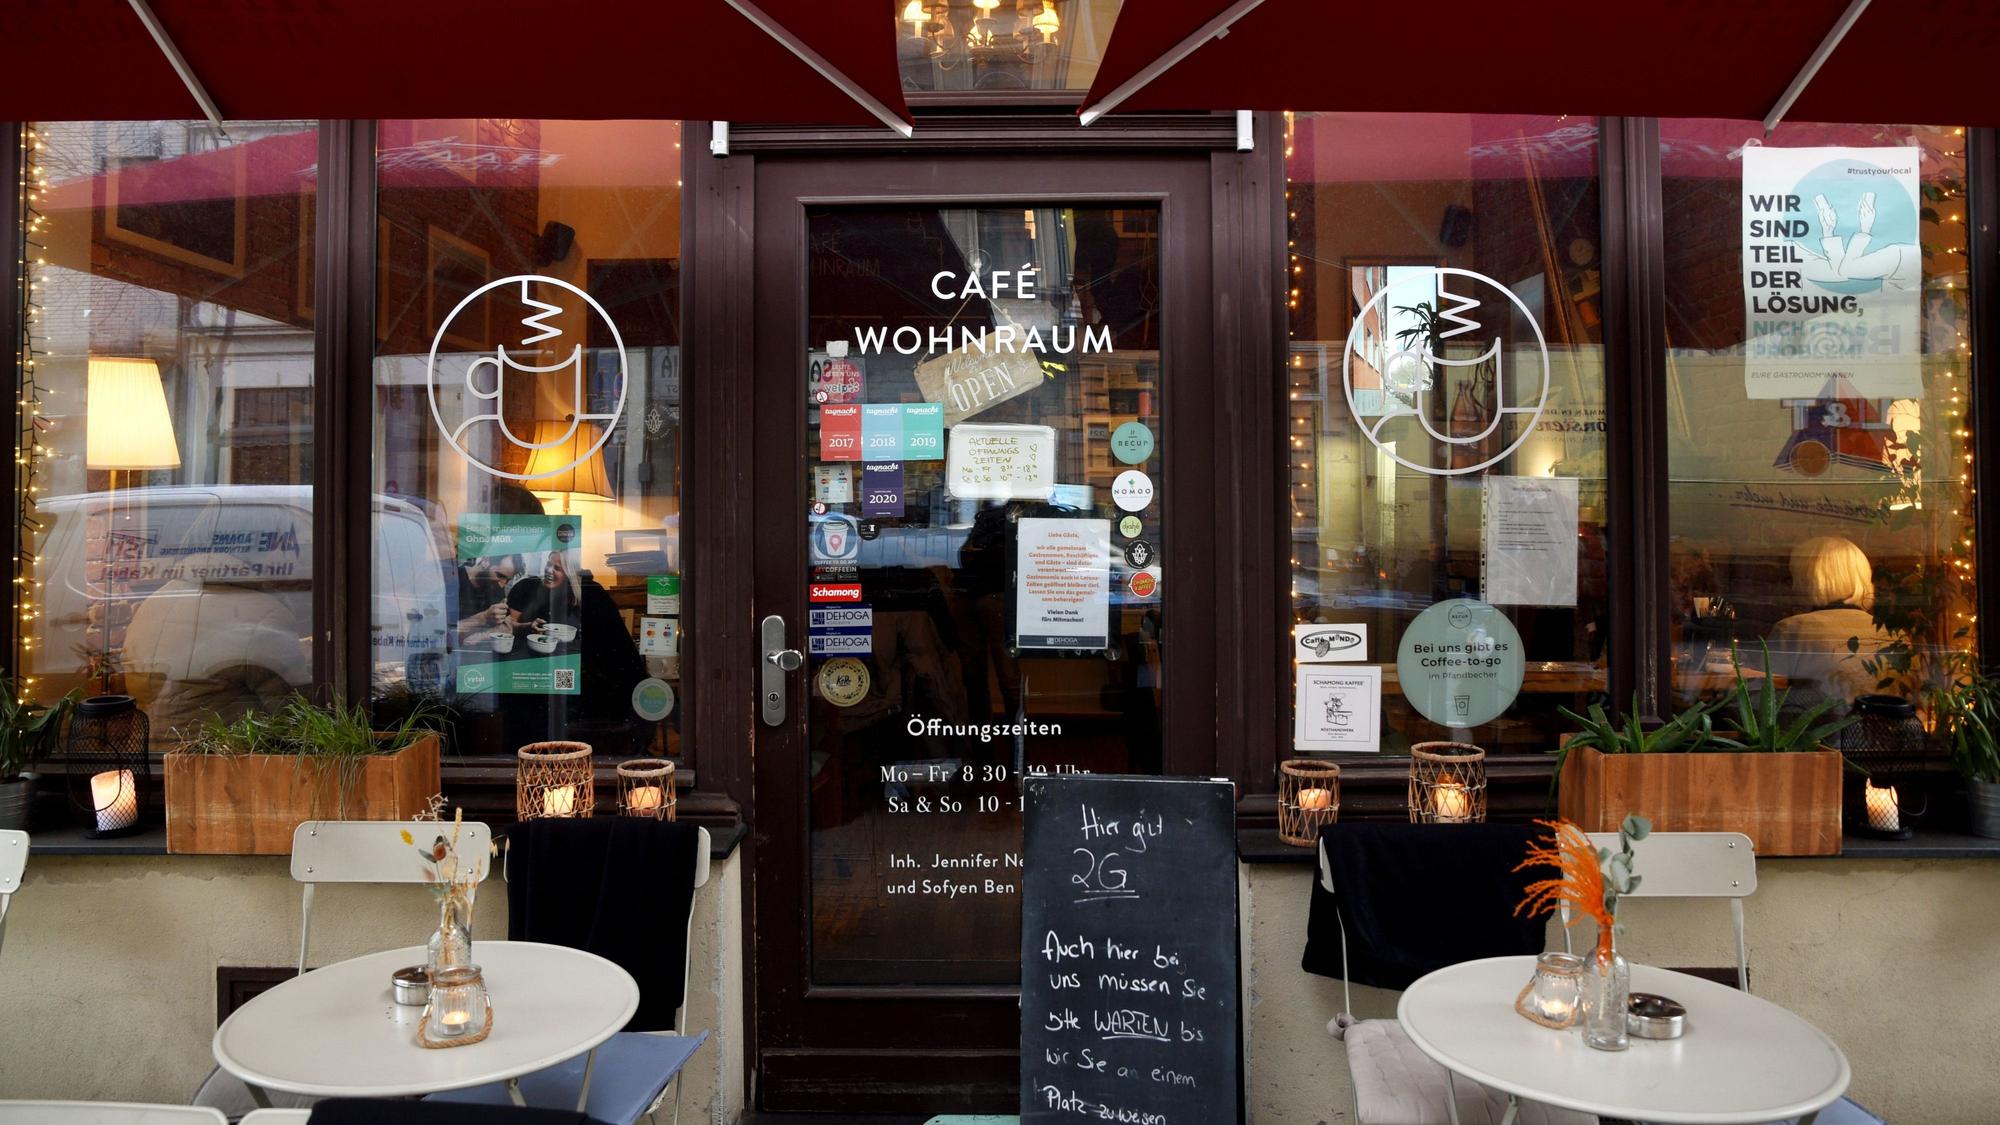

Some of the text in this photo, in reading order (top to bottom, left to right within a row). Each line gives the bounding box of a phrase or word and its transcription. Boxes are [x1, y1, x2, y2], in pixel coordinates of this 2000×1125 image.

[1847, 167, 1912, 176] #trustyourlocal
[1749, 194, 1801, 212] WIR
[1750, 219, 1810, 238] SIND
[1750, 245, 1803, 263] TEIL
[931, 262, 1036, 300] CAFÉ
[1750, 271, 1801, 288] DER
[1753, 291, 1864, 317] LÖSUNG,
[854, 325, 1114, 355] WOHNRAUM
[1752, 371, 1772, 379] EURE
[825, 383, 848, 394] yelp
[951, 362, 1016, 412] OPEN
[825, 406, 857, 416] tagnacht
[866, 406, 898, 416] tagnacht
[906, 406, 938, 415] tagnacht
[829, 438, 854, 448] 2017
[869, 436, 896, 447] 2018
[910, 436, 936, 447] 2019
[968, 437, 1018, 447] AKTUELLE
[973, 456, 1011, 464] ZEITEN
[866, 463, 899, 472] tagnacht
[869, 494, 897, 503] 2020
[465, 535, 490, 543] Ohne
[812, 587, 859, 598] Schamong
[826, 610, 870, 621] DEHOGA
[826, 637, 869, 647] DEHOGA
[1414, 643, 1508, 654] Bei uns gibt es
[1421, 656, 1502, 668] Coffee-to-go
[1429, 671, 1497, 680] im Pfandbecher
[907, 714, 1062, 743] Öffnungszeiten
[880, 765, 908, 782] Mo
[929, 765, 949, 782] Fr
[963, 765, 974, 782] 8
[982, 765, 1007, 782] 30
[888, 795, 909, 813] Sa
[916, 795, 932, 813] &
[939, 795, 962, 813] So
[978, 795, 999, 813] 10
[1081, 803, 1163, 853] Hier gilt
[891, 853, 921, 868] Inh.
[931, 853, 998, 868] Jennifer
[1071, 848, 1128, 890] 2G
[888, 880, 916, 894] und
[922, 880, 977, 899] Sofyen
[985, 880, 1014, 894] Ben
[1042, 930, 1179, 968] Auch hier bei
[1050, 973, 1206, 1000] uns müssen Sie
[1094, 1009, 1168, 1037] WARTEN
[1181, 1020, 1204, 1042] bis
[1046, 1048, 1196, 1088] wir Sie an einem
[1043, 1085, 1087, 1114] Platz
